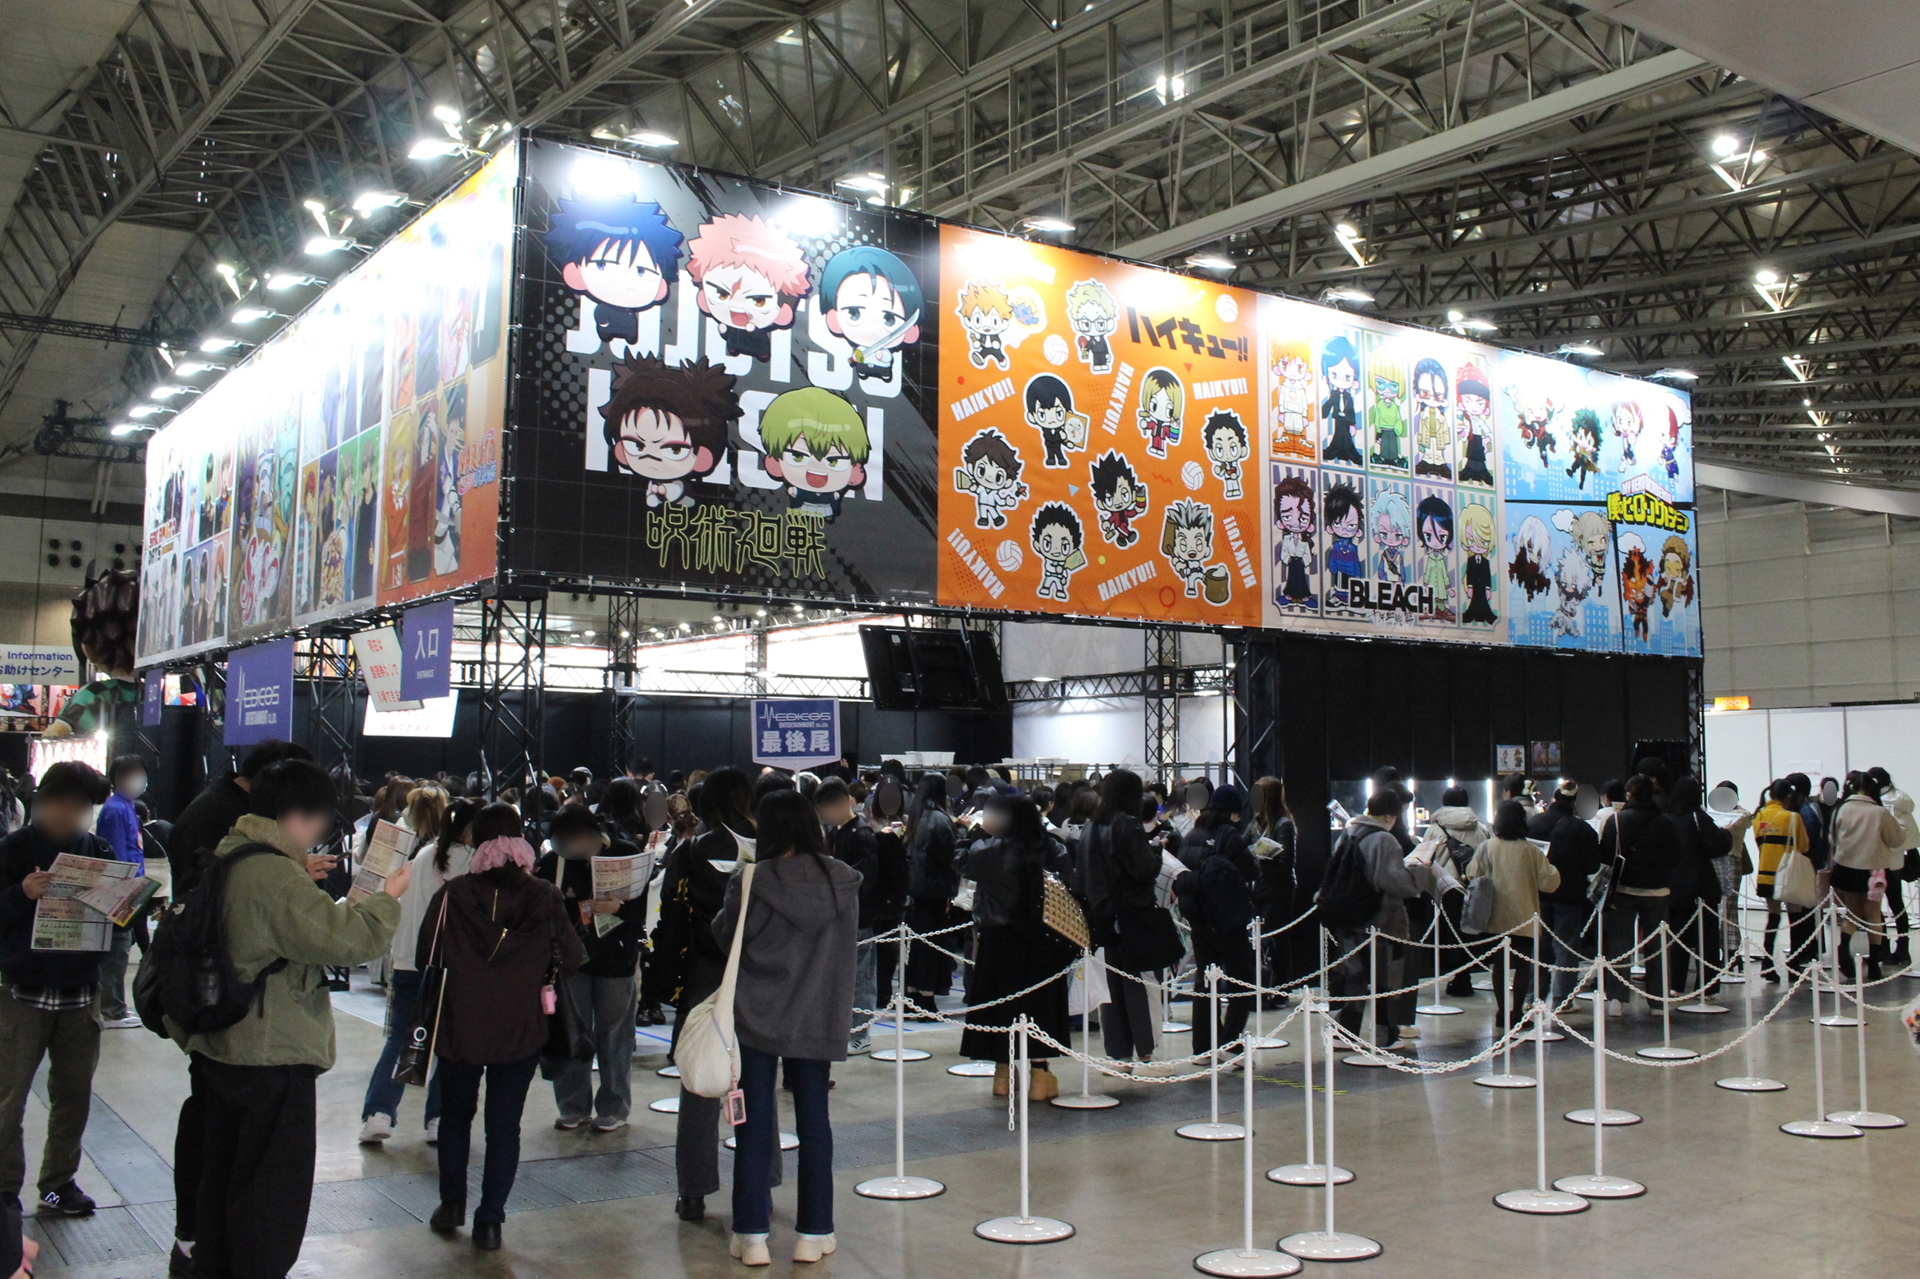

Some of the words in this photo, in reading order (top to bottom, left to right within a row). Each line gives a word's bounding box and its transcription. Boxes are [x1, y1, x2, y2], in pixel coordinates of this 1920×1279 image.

[1126, 306, 1249, 362] ハイキュー!!
[951, 377, 1016, 422] HAIKYU!!
[1102, 361, 1135, 435] HAIKYU!!
[1192, 377, 1249, 400] HAIKYU!!
[646, 501, 826, 580] 呪術廻戦
[1222, 516, 1257, 588] HAIKYU!!
[946, 528, 1005, 599] HAIKYU!!
[1097, 560, 1157, 602] HAIKYU!!
[1350, 578, 1434, 615] BLEACH
[8, 651, 73, 661] Information
[414, 628, 439, 660] 入口
[235, 665, 280, 726] MEDICOS
[760, 703, 832, 728] MEDICOS
[761, 729, 830, 754] 最後尾
